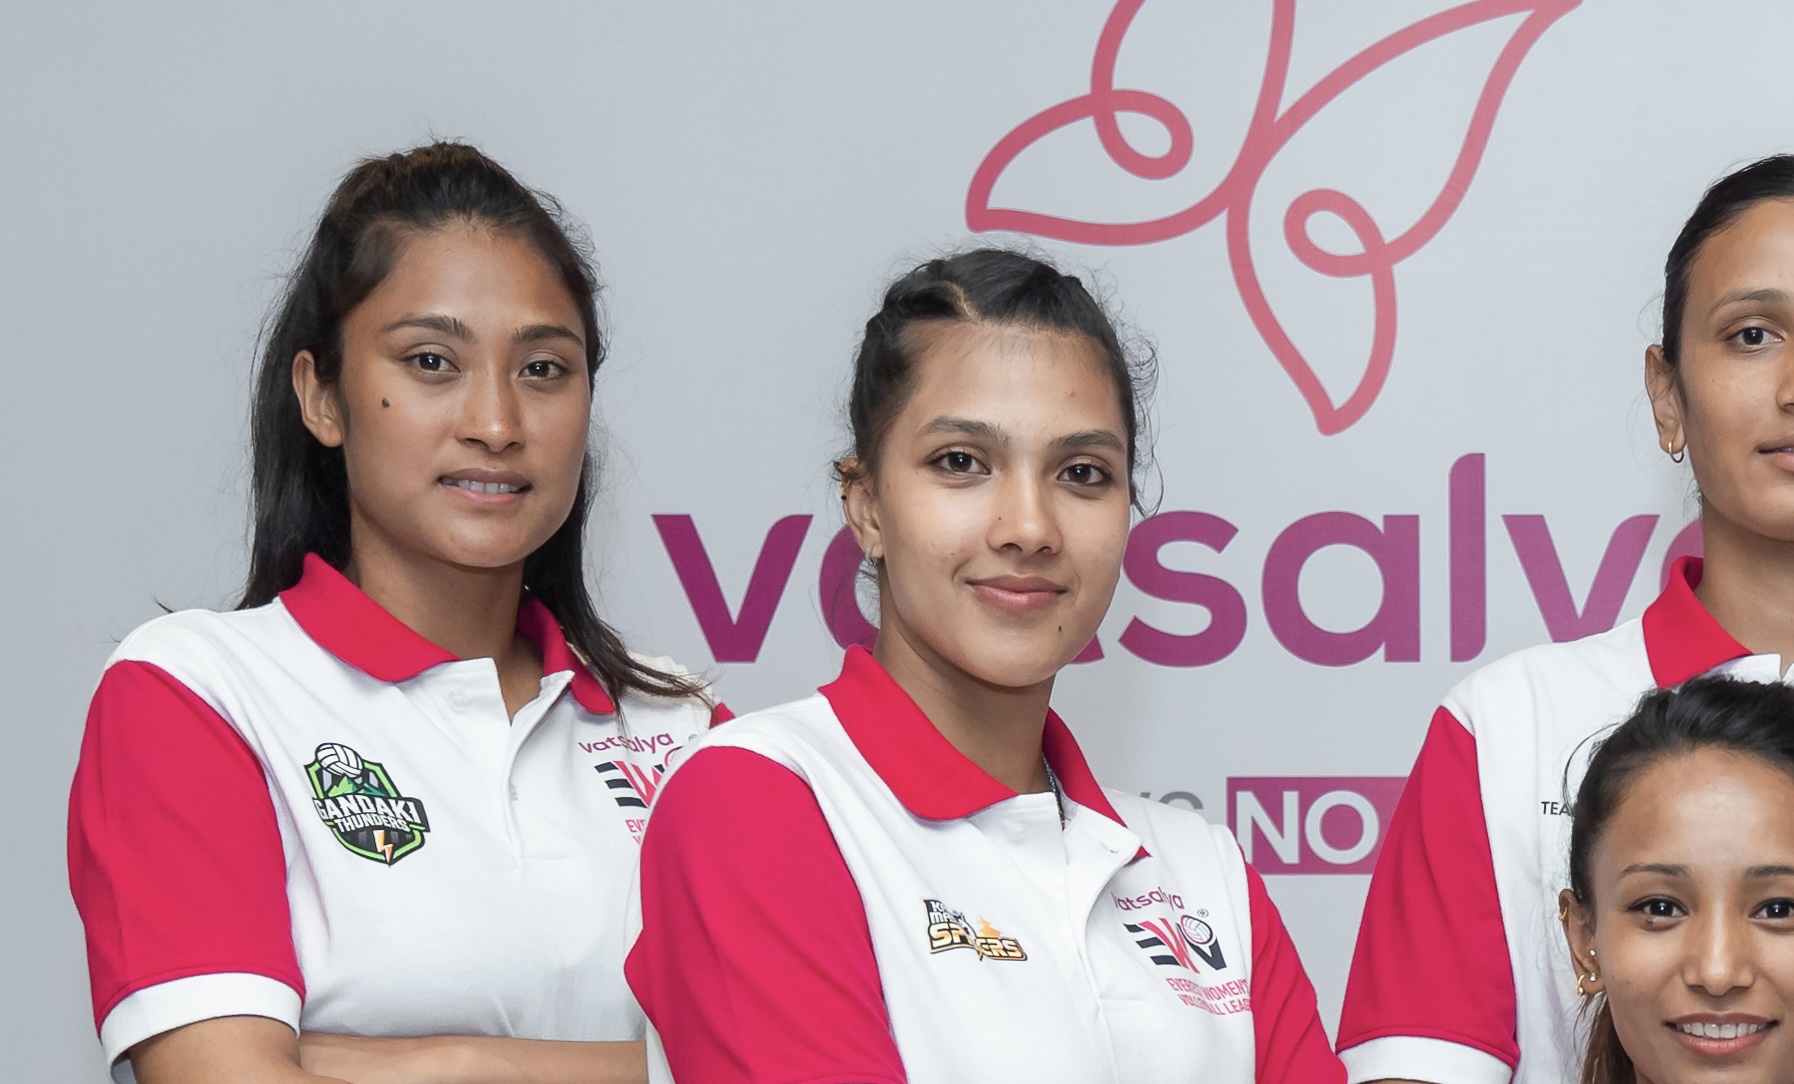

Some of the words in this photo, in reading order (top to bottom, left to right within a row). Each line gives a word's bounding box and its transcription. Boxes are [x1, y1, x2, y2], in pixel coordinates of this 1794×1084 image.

[312, 793, 422, 825] GANDAKI
[333, 811, 412, 834] THUNDERS
[1235, 788, 1380, 866] NO
